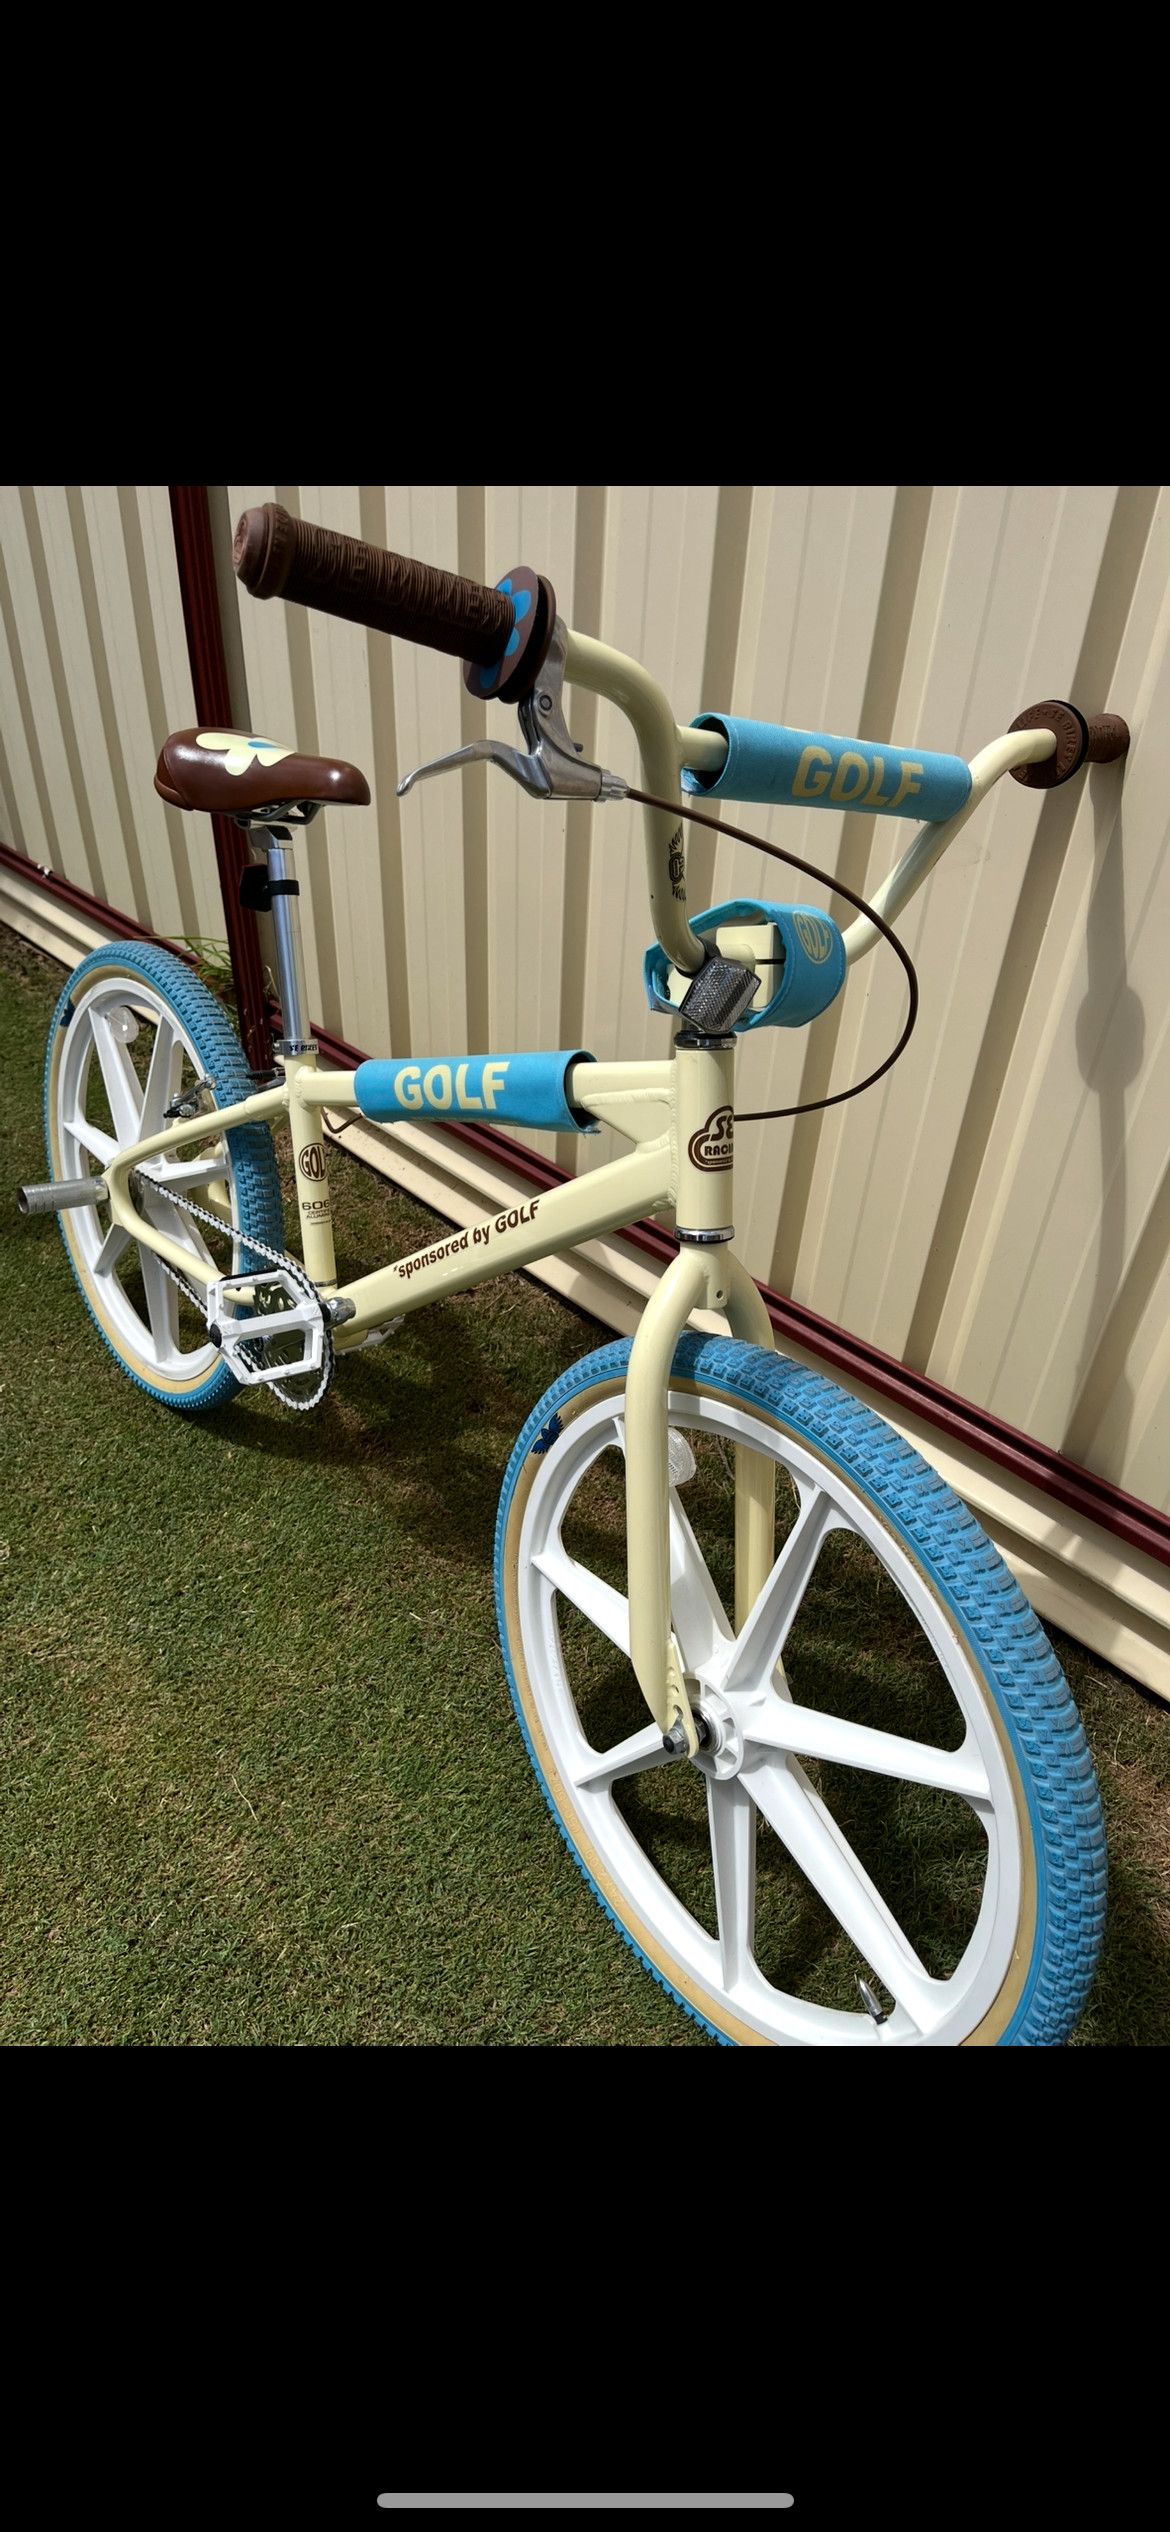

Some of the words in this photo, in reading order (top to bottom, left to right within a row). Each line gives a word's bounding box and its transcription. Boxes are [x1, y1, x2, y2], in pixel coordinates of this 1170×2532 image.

[791, 745, 925, 809] GOLF
[796, 913, 830, 960] GOLF
[394, 1061, 510, 1110] GOLF
[301, 1145, 327, 1179] GOL
[704, 1143, 734, 1156] RACI
[473, 1225, 490, 1245] by
[495, 1200, 540, 1233] GOLF
